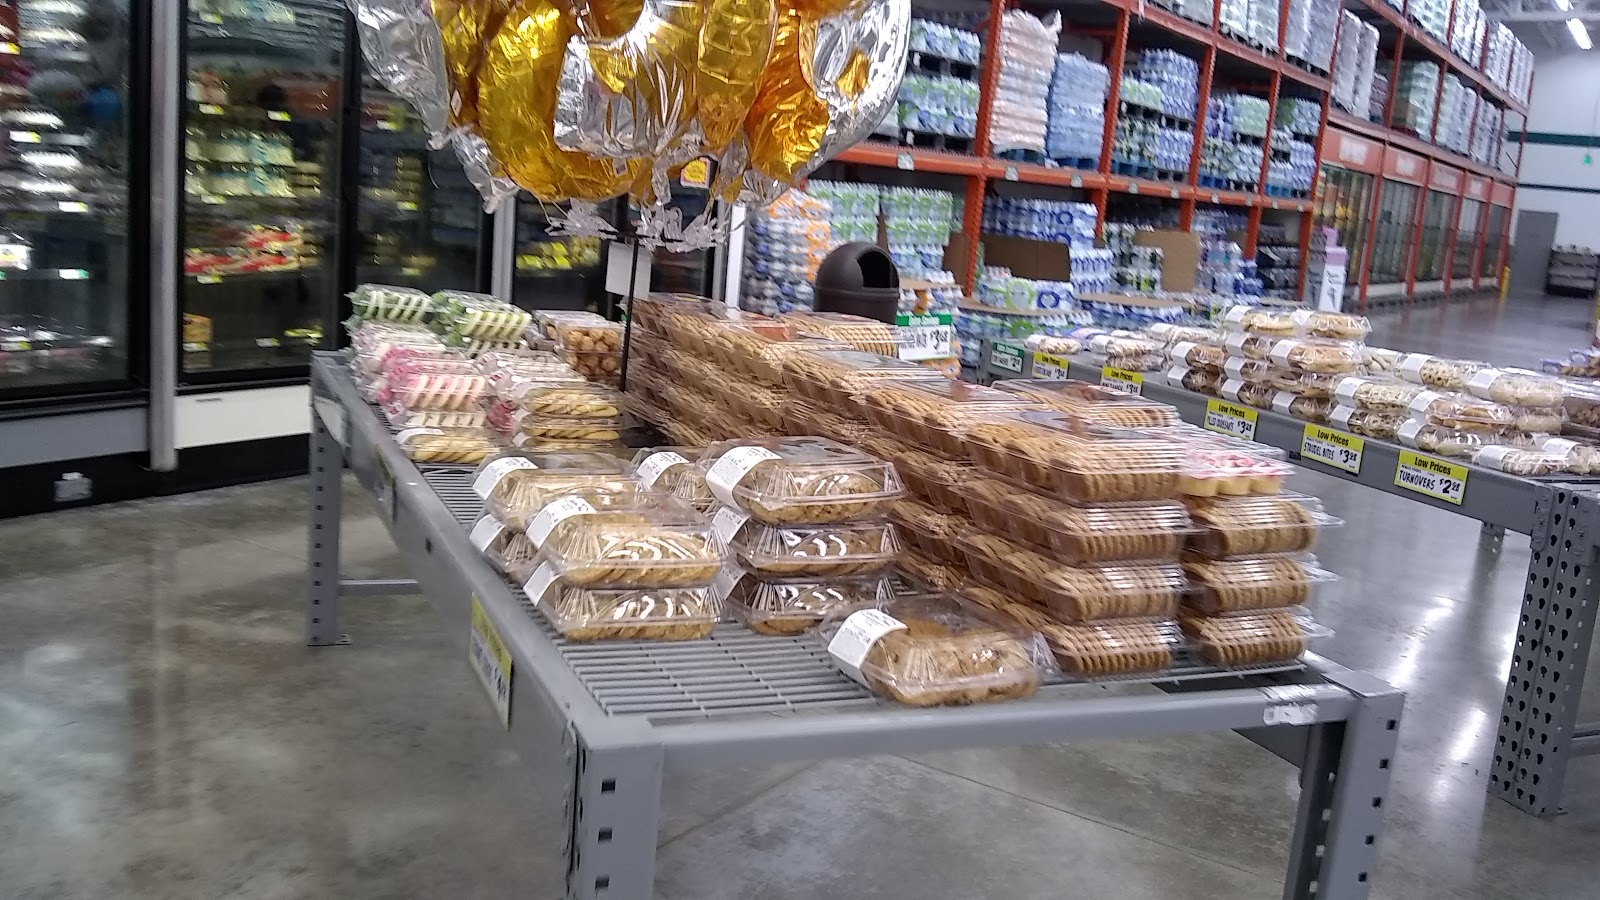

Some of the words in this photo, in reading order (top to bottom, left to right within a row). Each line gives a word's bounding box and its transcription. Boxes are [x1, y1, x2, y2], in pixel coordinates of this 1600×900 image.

[1218, 403, 1229, 413] Low
[1229, 405, 1246, 418] Prices
[1317, 429, 1330, 440] Low
[1329, 433, 1350, 447] Prices
[1414, 456, 1429, 468] Low
[1429, 460, 1452, 475] Prices
[1398, 469, 1436, 491] TURNOVERS
